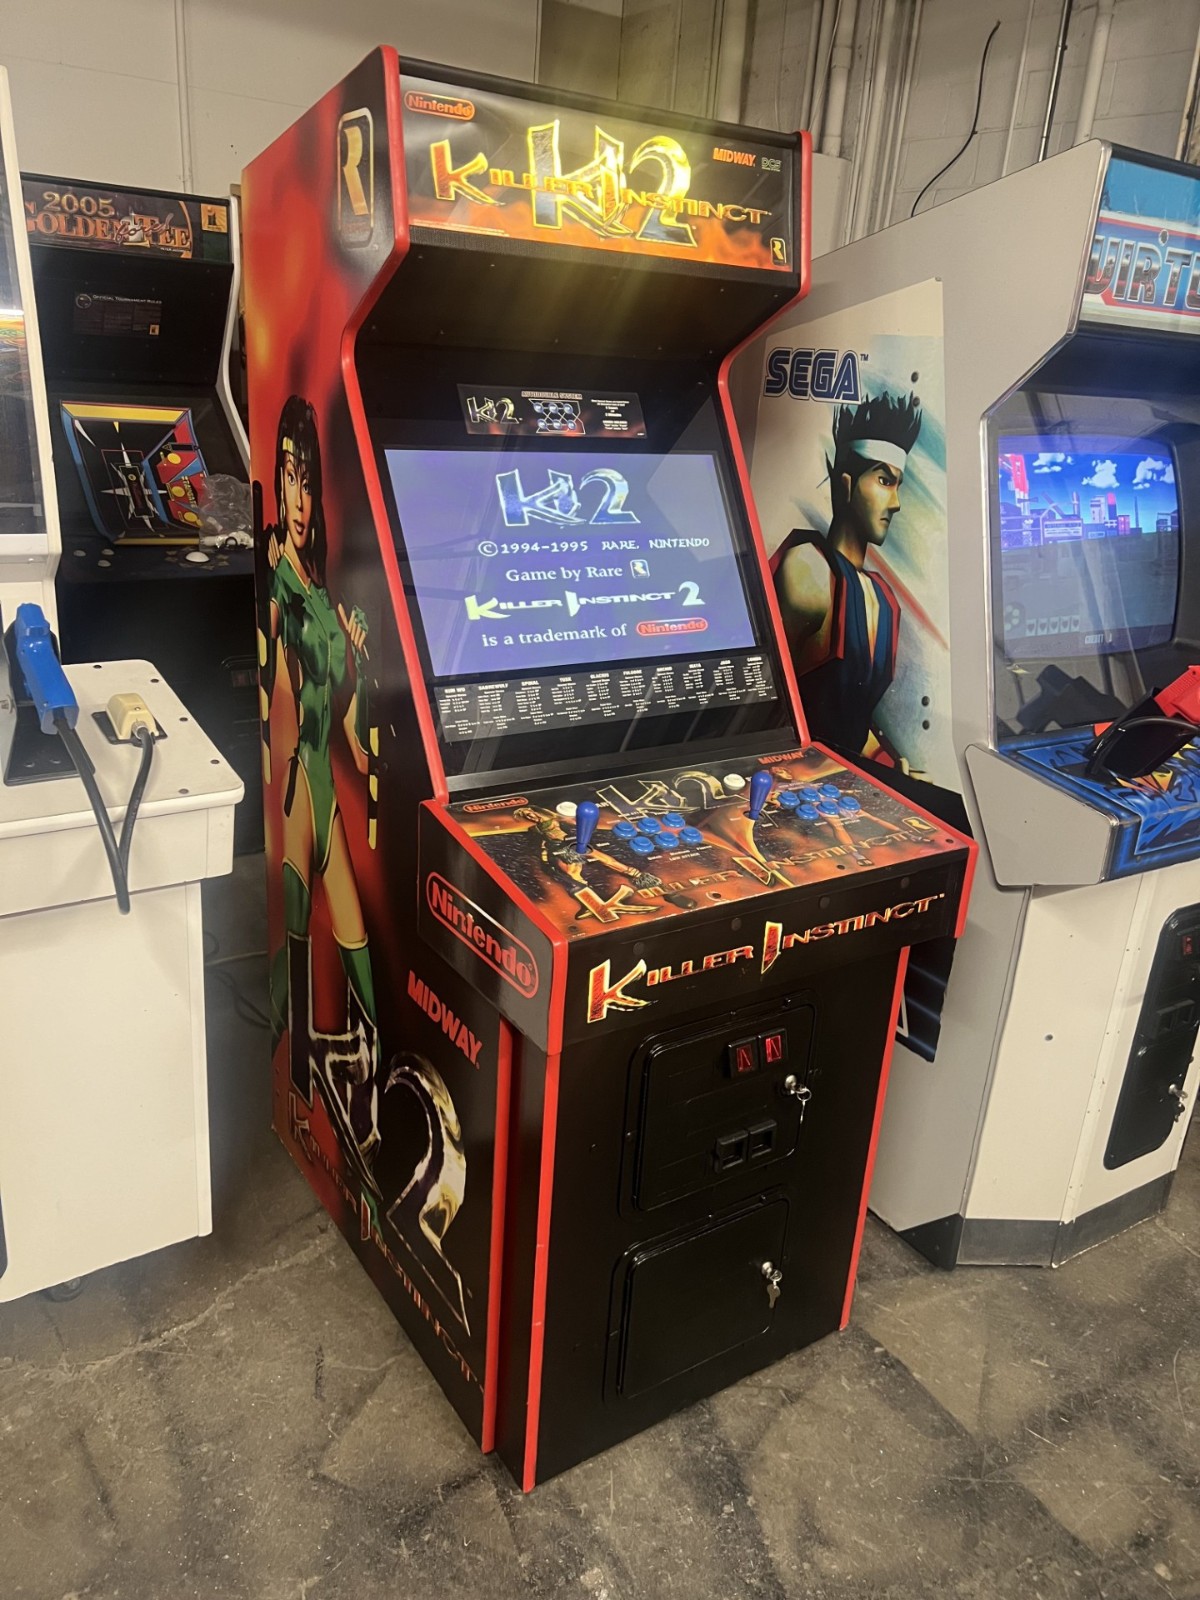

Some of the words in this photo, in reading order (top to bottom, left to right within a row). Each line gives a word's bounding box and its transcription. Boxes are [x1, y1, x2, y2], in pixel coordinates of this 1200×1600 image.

[407, 93, 474, 118] Nintendo
[712, 147, 757, 167] MIDWAY
[761, 157, 782, 169] DCS
[430, 139, 597, 205] KILLER
[600, 165, 767, 224] INSTINCT
[43, 191, 115, 217] 2005
[763, 346, 862, 405] SEGA
[649, 537, 710, 550] NINTENDO
[506, 567, 556, 582] Game
[561, 566, 581, 582] by
[587, 564, 623, 579] Rare
[465, 594, 562, 621] KILLER
[564, 590, 676, 617] INSTINCT
[678, 581, 706, 606] 2
[482, 633, 498, 647] is
[504, 635, 514, 646] a
[518, 625, 606, 645] trademark
[610, 623, 628, 638] of
[640, 619, 704, 634] Nintendo
[757, 750, 804, 765] MIDWAY
[465, 797, 527, 812] Nintendo
[574, 869, 743, 924] KILLER
[732, 830, 912, 887] INSTINCT
[431, 880, 537, 991] Nintendo
[587, 944, 754, 1024] KILLER
[761, 894, 936, 975] INSTINCT
[407, 970, 483, 1069] MIDWAY
